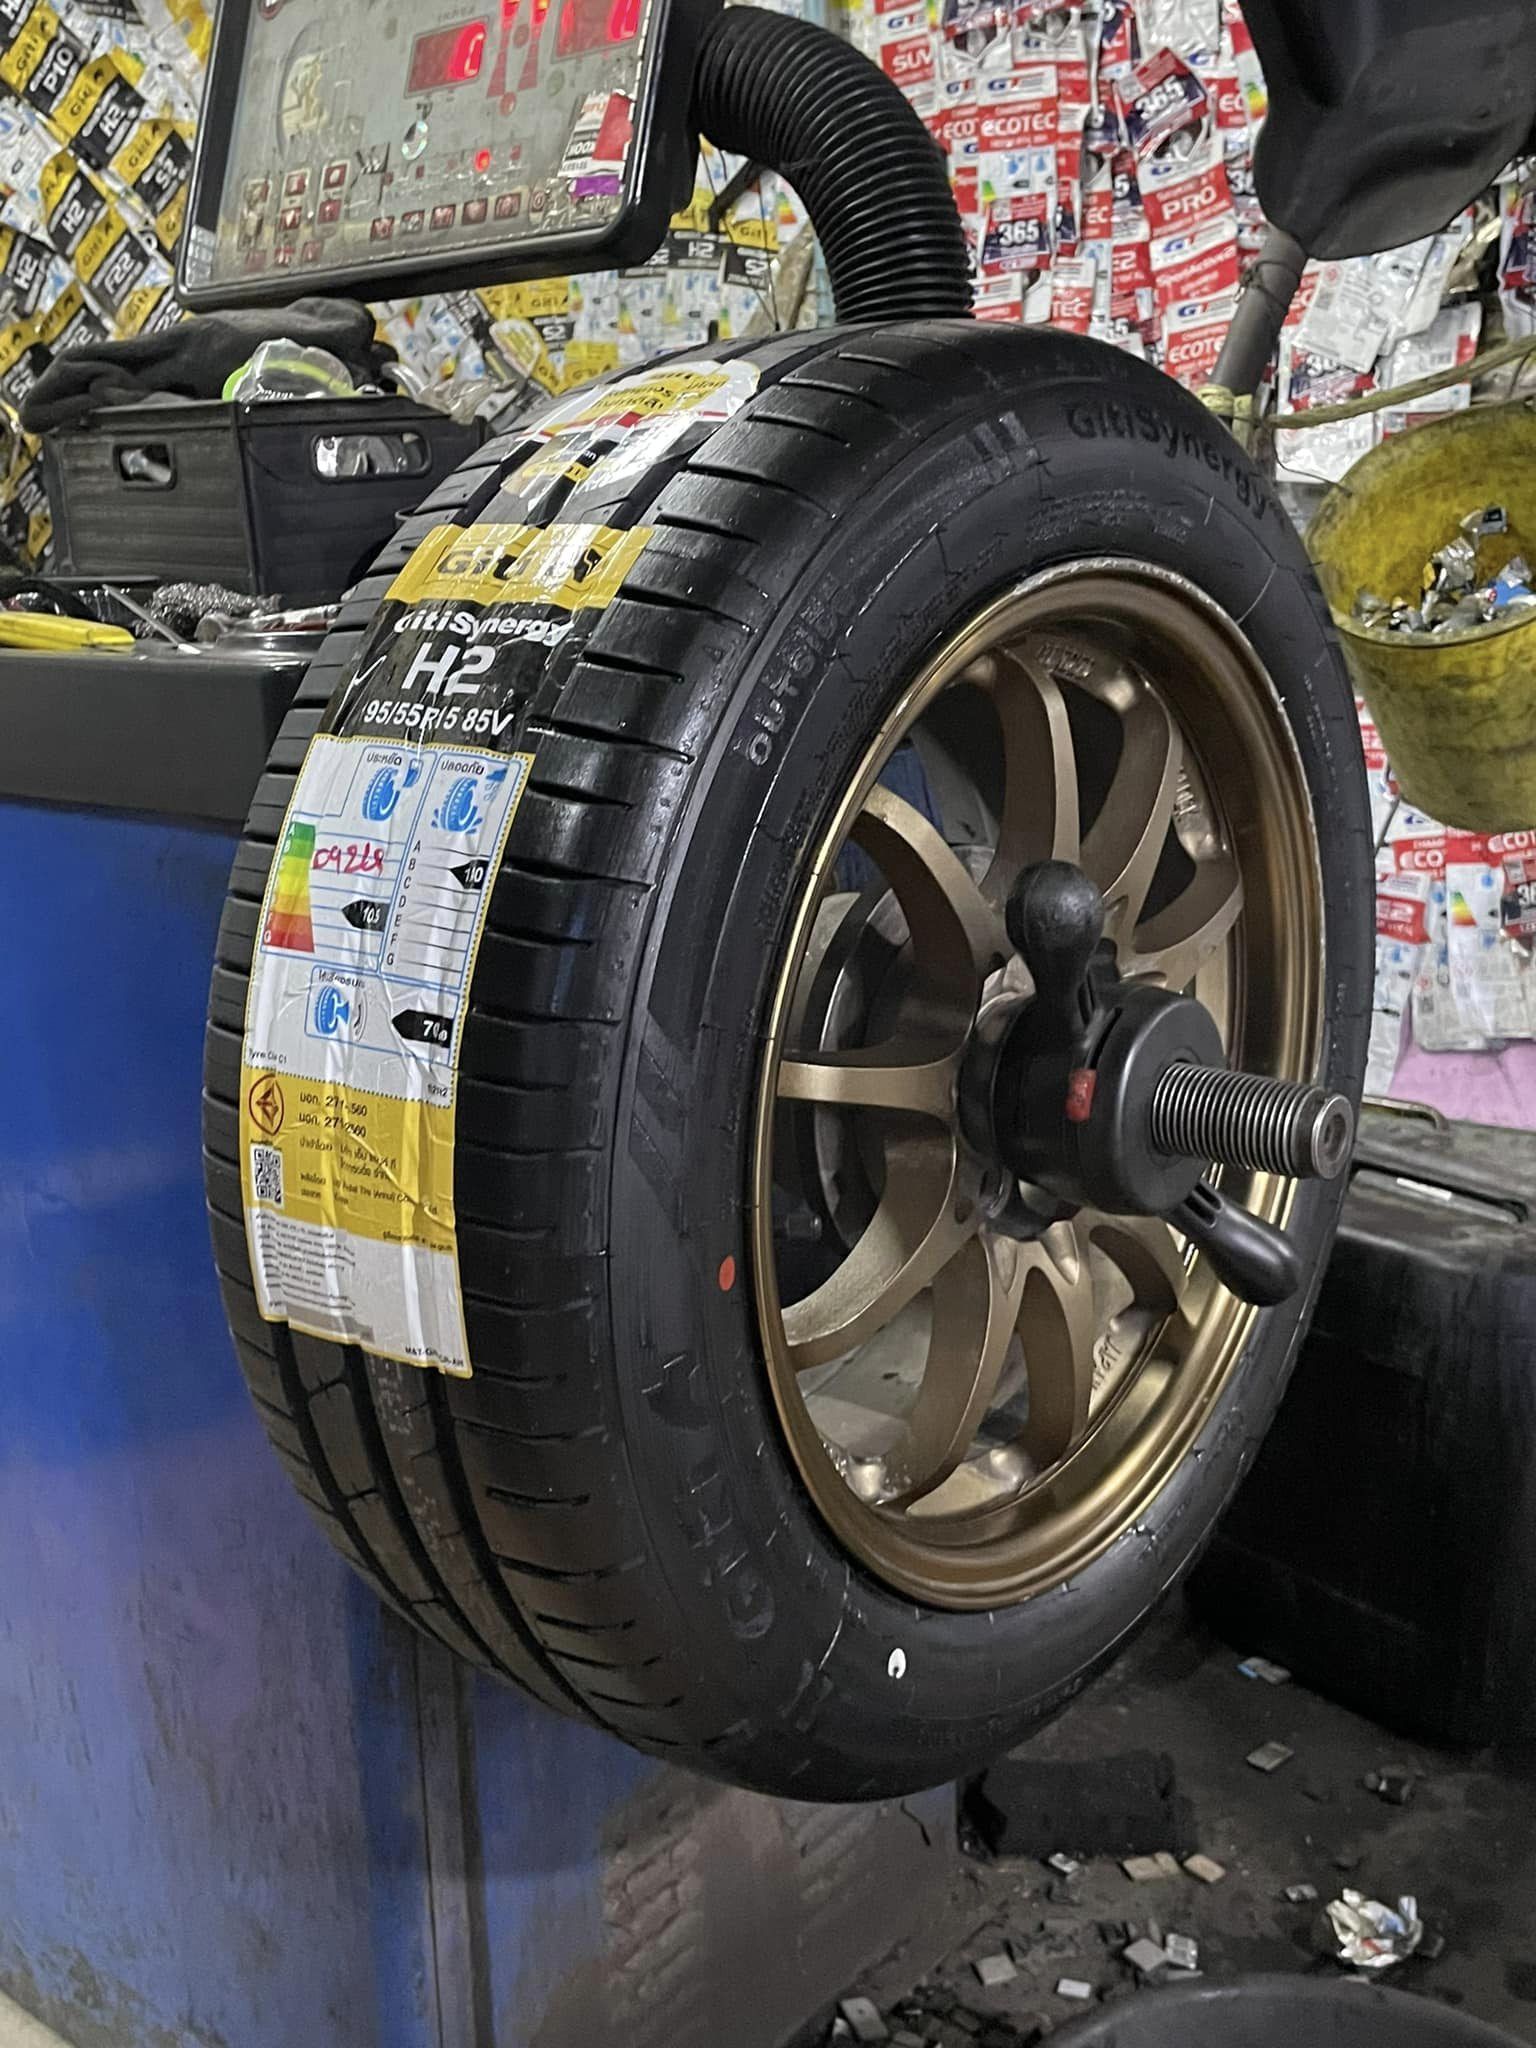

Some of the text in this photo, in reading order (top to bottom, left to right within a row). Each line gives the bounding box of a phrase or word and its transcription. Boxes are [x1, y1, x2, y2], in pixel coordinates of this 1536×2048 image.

[43, 48, 73, 93] P10
[1135, 75, 1185, 120] 365
[100, 104, 126, 138] H2
[61, 199, 86, 235] H2
[1162, 185, 1217, 221] PRO
[1000, 219, 1040, 248] 365
[688, 241, 715, 258] H2
[14, 253, 39, 290] H2
[401, 642, 496, 697] H2
[463, 707, 514, 737] 85V
[414, 840, 421, 853] A
[408, 858, 416, 870] B
[404, 876, 411, 889] C
[399, 895, 406, 908] D
[395, 914, 402, 927] E
[390, 934, 398, 946] F
[387, 953, 394, 966] G
